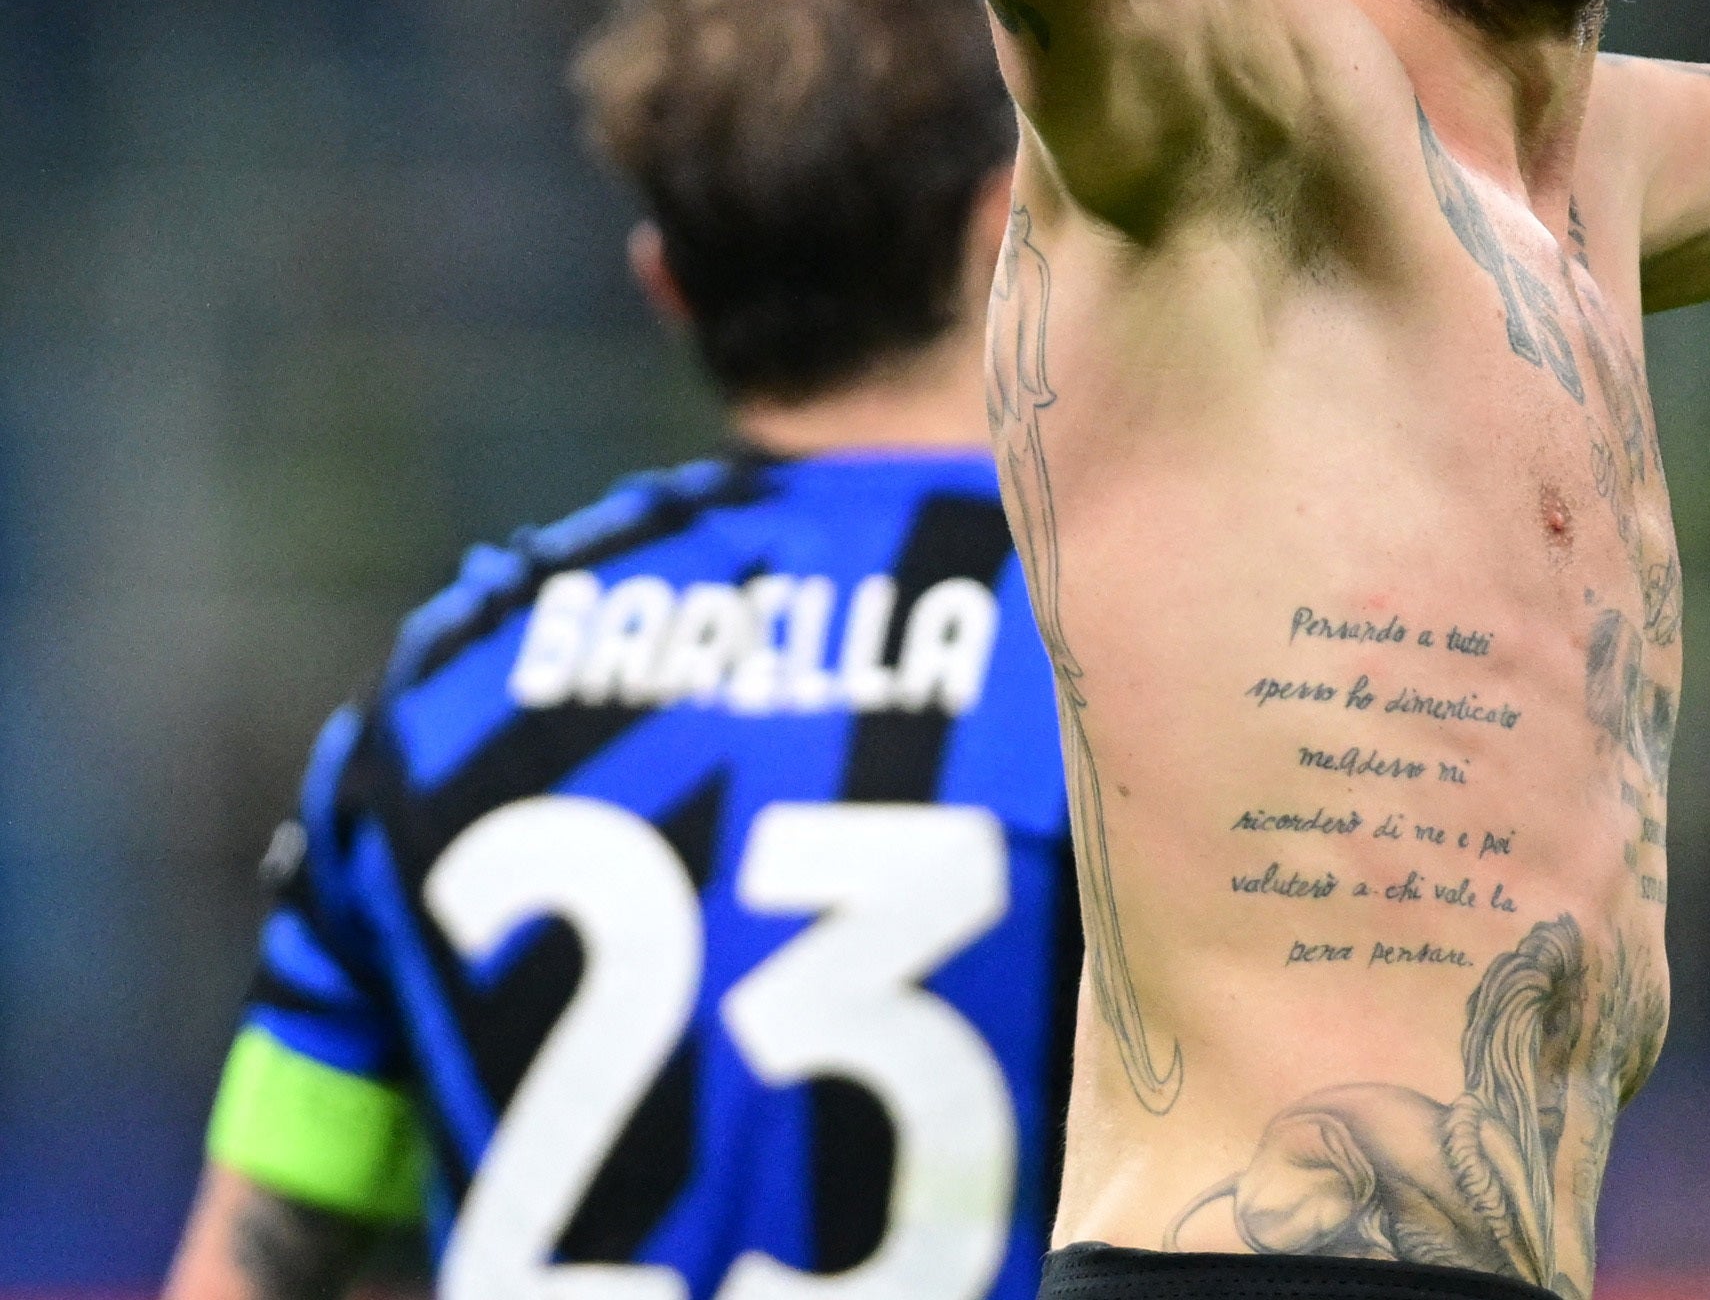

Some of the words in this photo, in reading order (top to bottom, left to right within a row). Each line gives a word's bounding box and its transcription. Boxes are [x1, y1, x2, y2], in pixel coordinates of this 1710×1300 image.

[506, 570, 1001, 717] BARELLA
[1289, 606, 1408, 646] Pensando
[1418, 629, 1434, 647] a
[1447, 625, 1494, 657] tutti
[1346, 674, 1376, 710] ho
[1385, 687, 1521, 731] dimenticato
[1438, 758, 1468, 785] mi
[1372, 814, 1404, 840] di
[1414, 823, 1446, 846] me
[1457, 831, 1470, 848] e
[1479, 830, 1517, 860] poi
[1385, 870, 1426, 903] chi
[1434, 877, 1477, 909] vale
[1490, 883, 1518, 913] la
[1285, 939, 1354, 968] pena
[421, 794, 1020, 1300] 23
